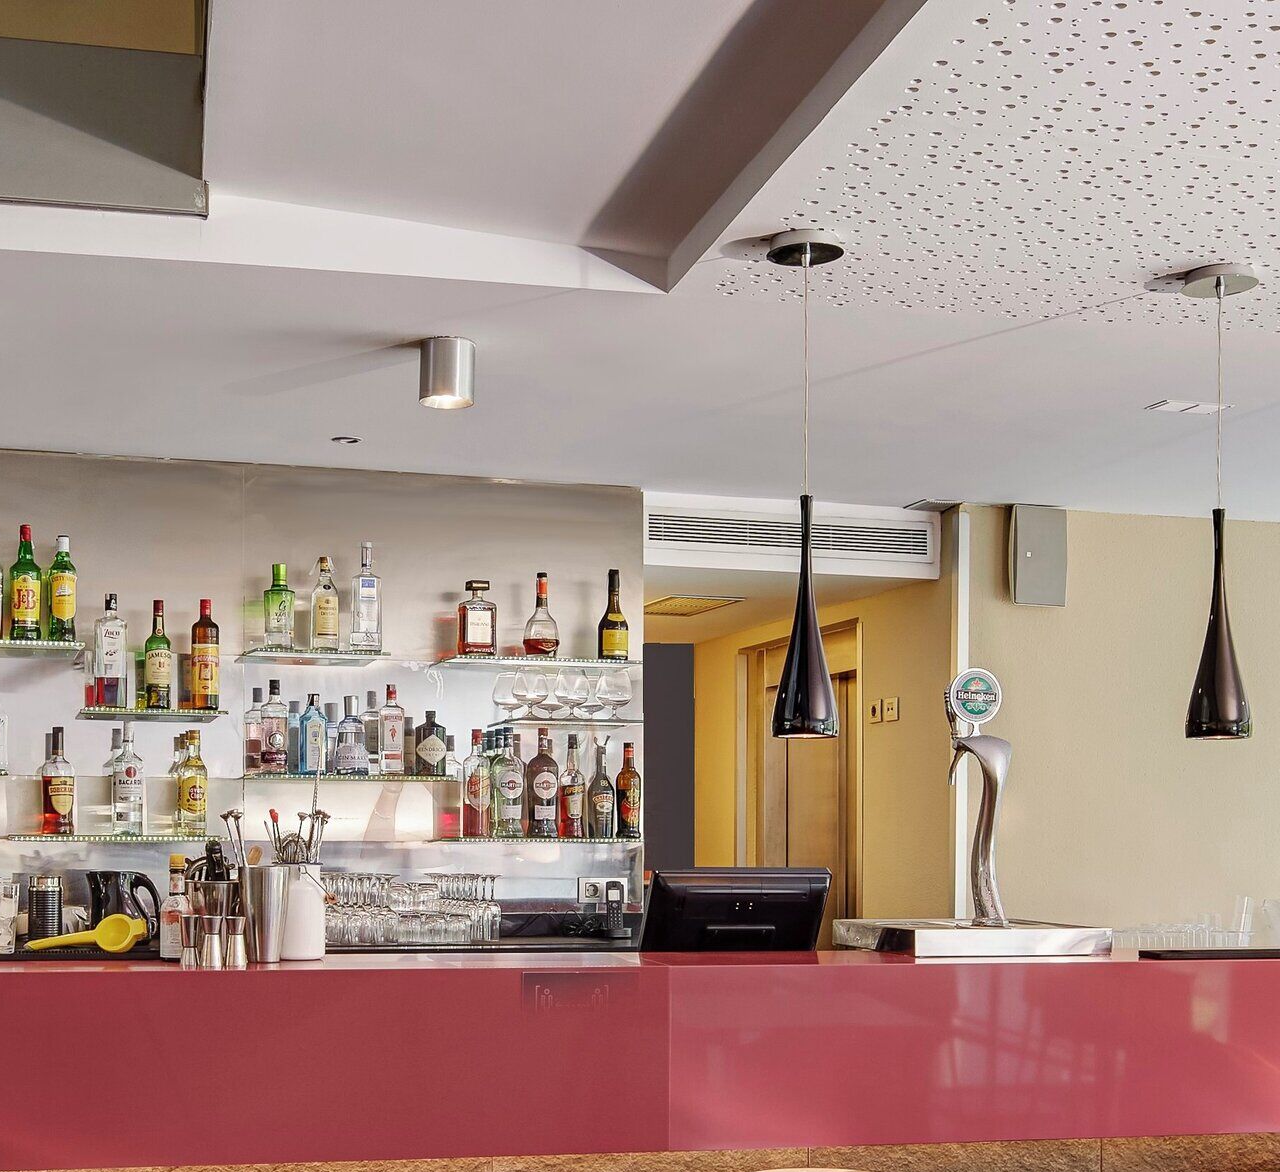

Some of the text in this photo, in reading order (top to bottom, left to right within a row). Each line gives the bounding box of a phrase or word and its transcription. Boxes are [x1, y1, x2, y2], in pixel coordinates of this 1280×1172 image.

[147, 650, 173, 660] JAMESO
[957, 690, 995, 701] Heineken
[50, 785, 74, 794] SOBERAN
